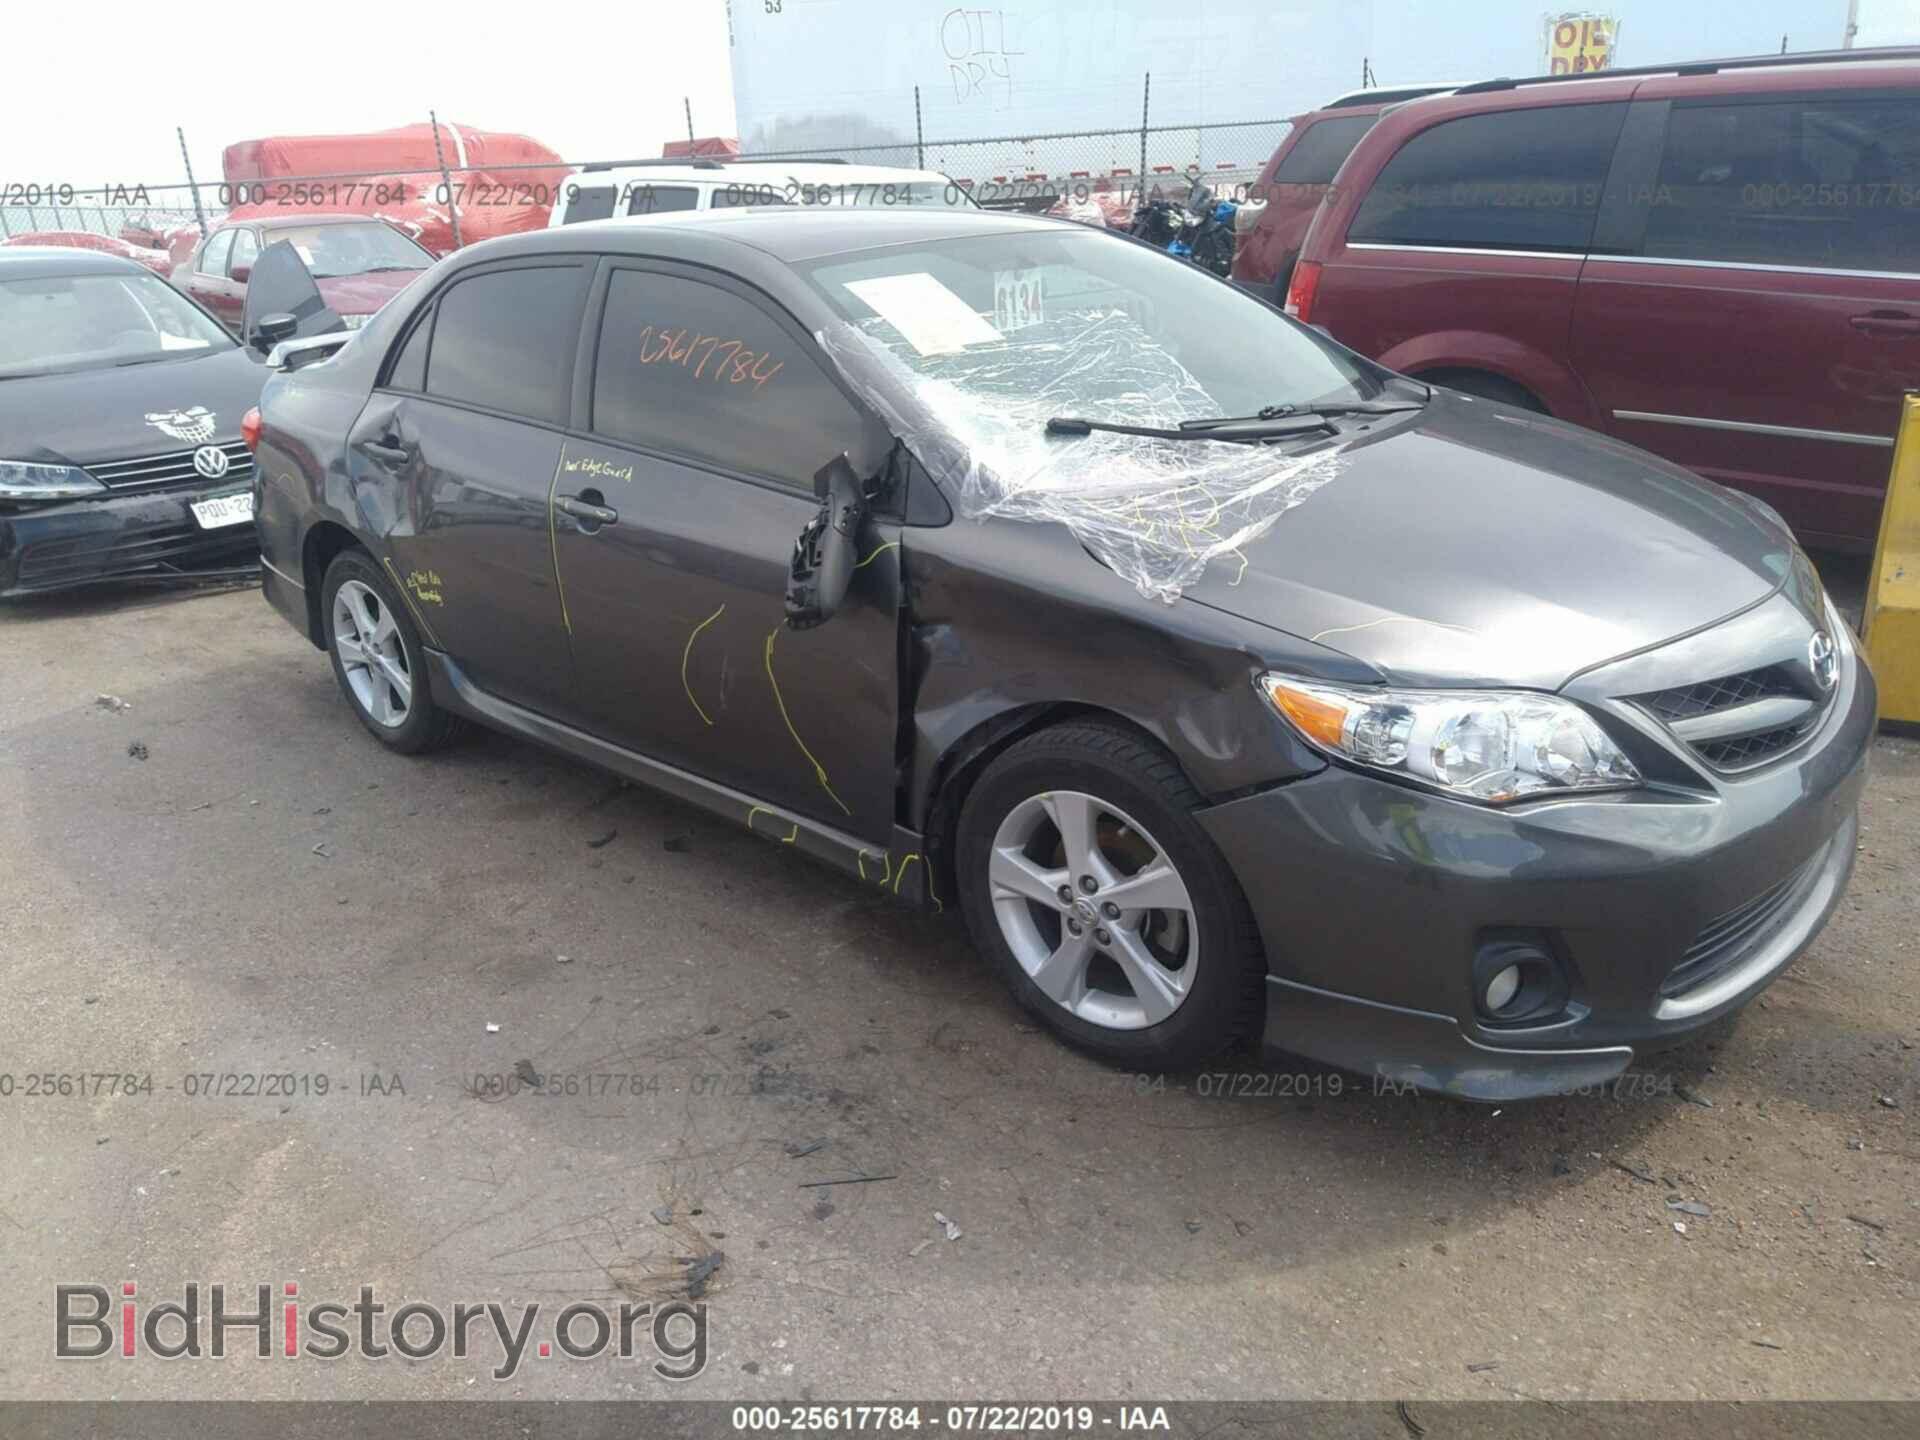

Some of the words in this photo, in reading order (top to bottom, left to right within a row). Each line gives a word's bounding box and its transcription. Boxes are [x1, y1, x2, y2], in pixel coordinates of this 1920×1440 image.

[764, 0, 782, 14] 53
[940, 8, 1025, 60] OIL
[1554, 20, 1608, 48] OIL
